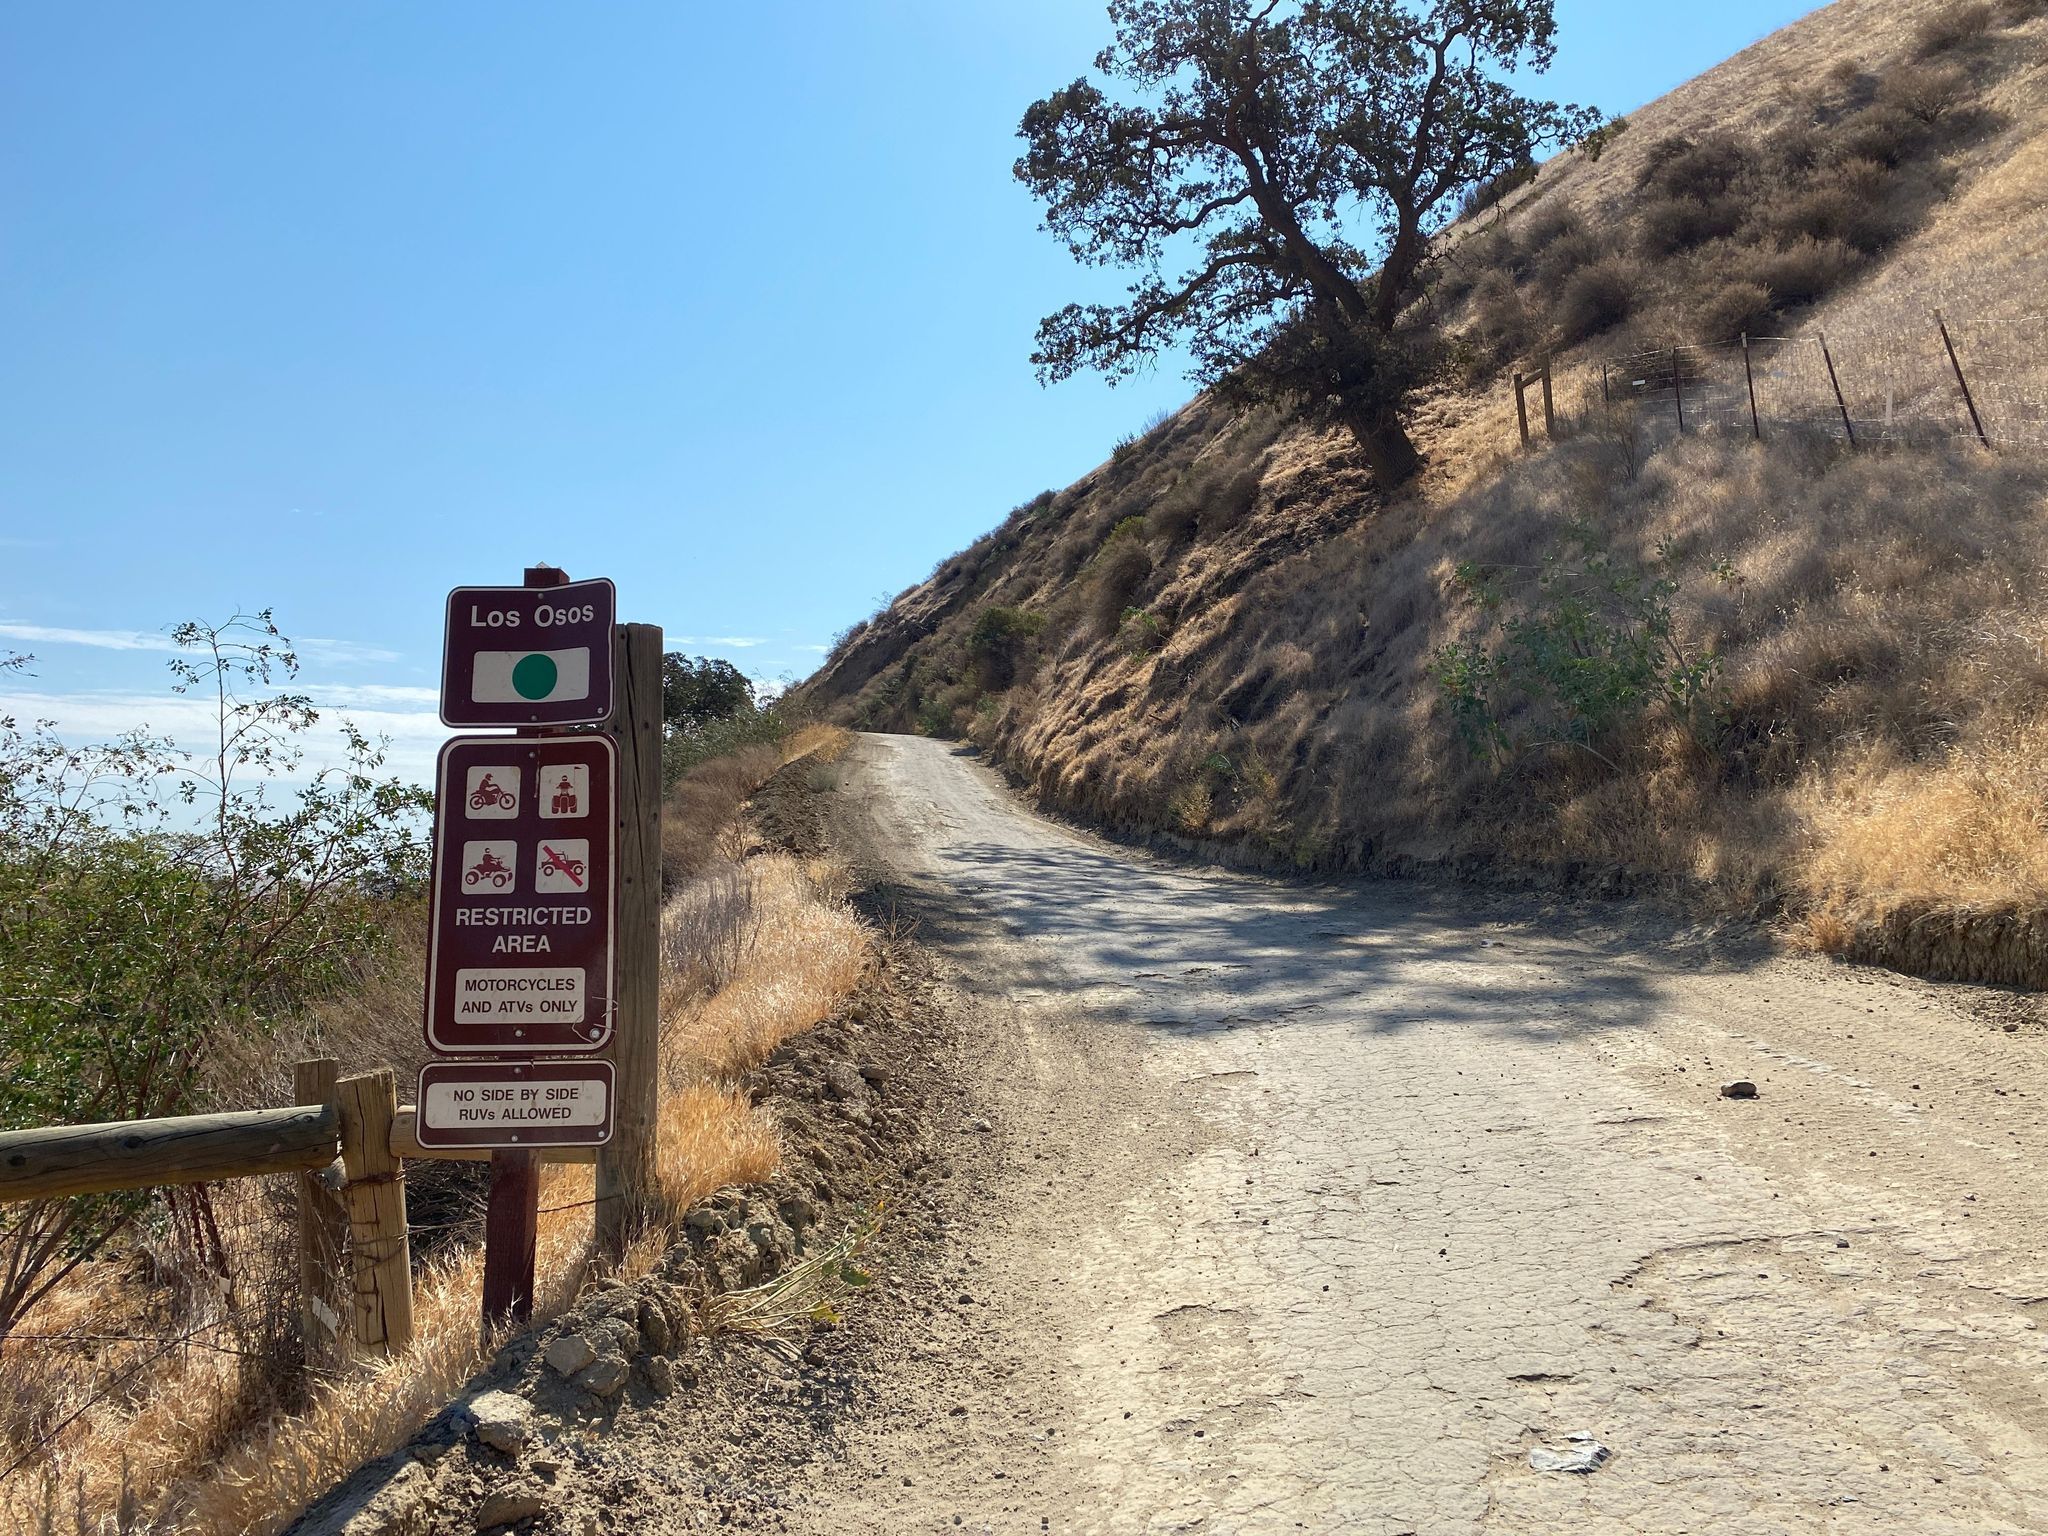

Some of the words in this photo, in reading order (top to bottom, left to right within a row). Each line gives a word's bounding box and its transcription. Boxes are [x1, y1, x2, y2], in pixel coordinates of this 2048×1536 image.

[455, 907, 592, 926] RESTRICTED
[491, 935, 551, 953] AREA
[464, 978, 576, 992] MOTORCYCLES
[461, 1000, 492, 1013] AND
[498, 1000, 533, 1013] ATVs
[539, 1000, 578, 1013] ONLY
[453, 1089, 475, 1102] NO
[481, 1089, 514, 1101] SIDE
[520, 1088, 539, 1101] BY
[545, 1087, 579, 1100] SIDE
[458, 1108, 495, 1121] RUVs
[501, 1107, 572, 1120] ALLOWED
